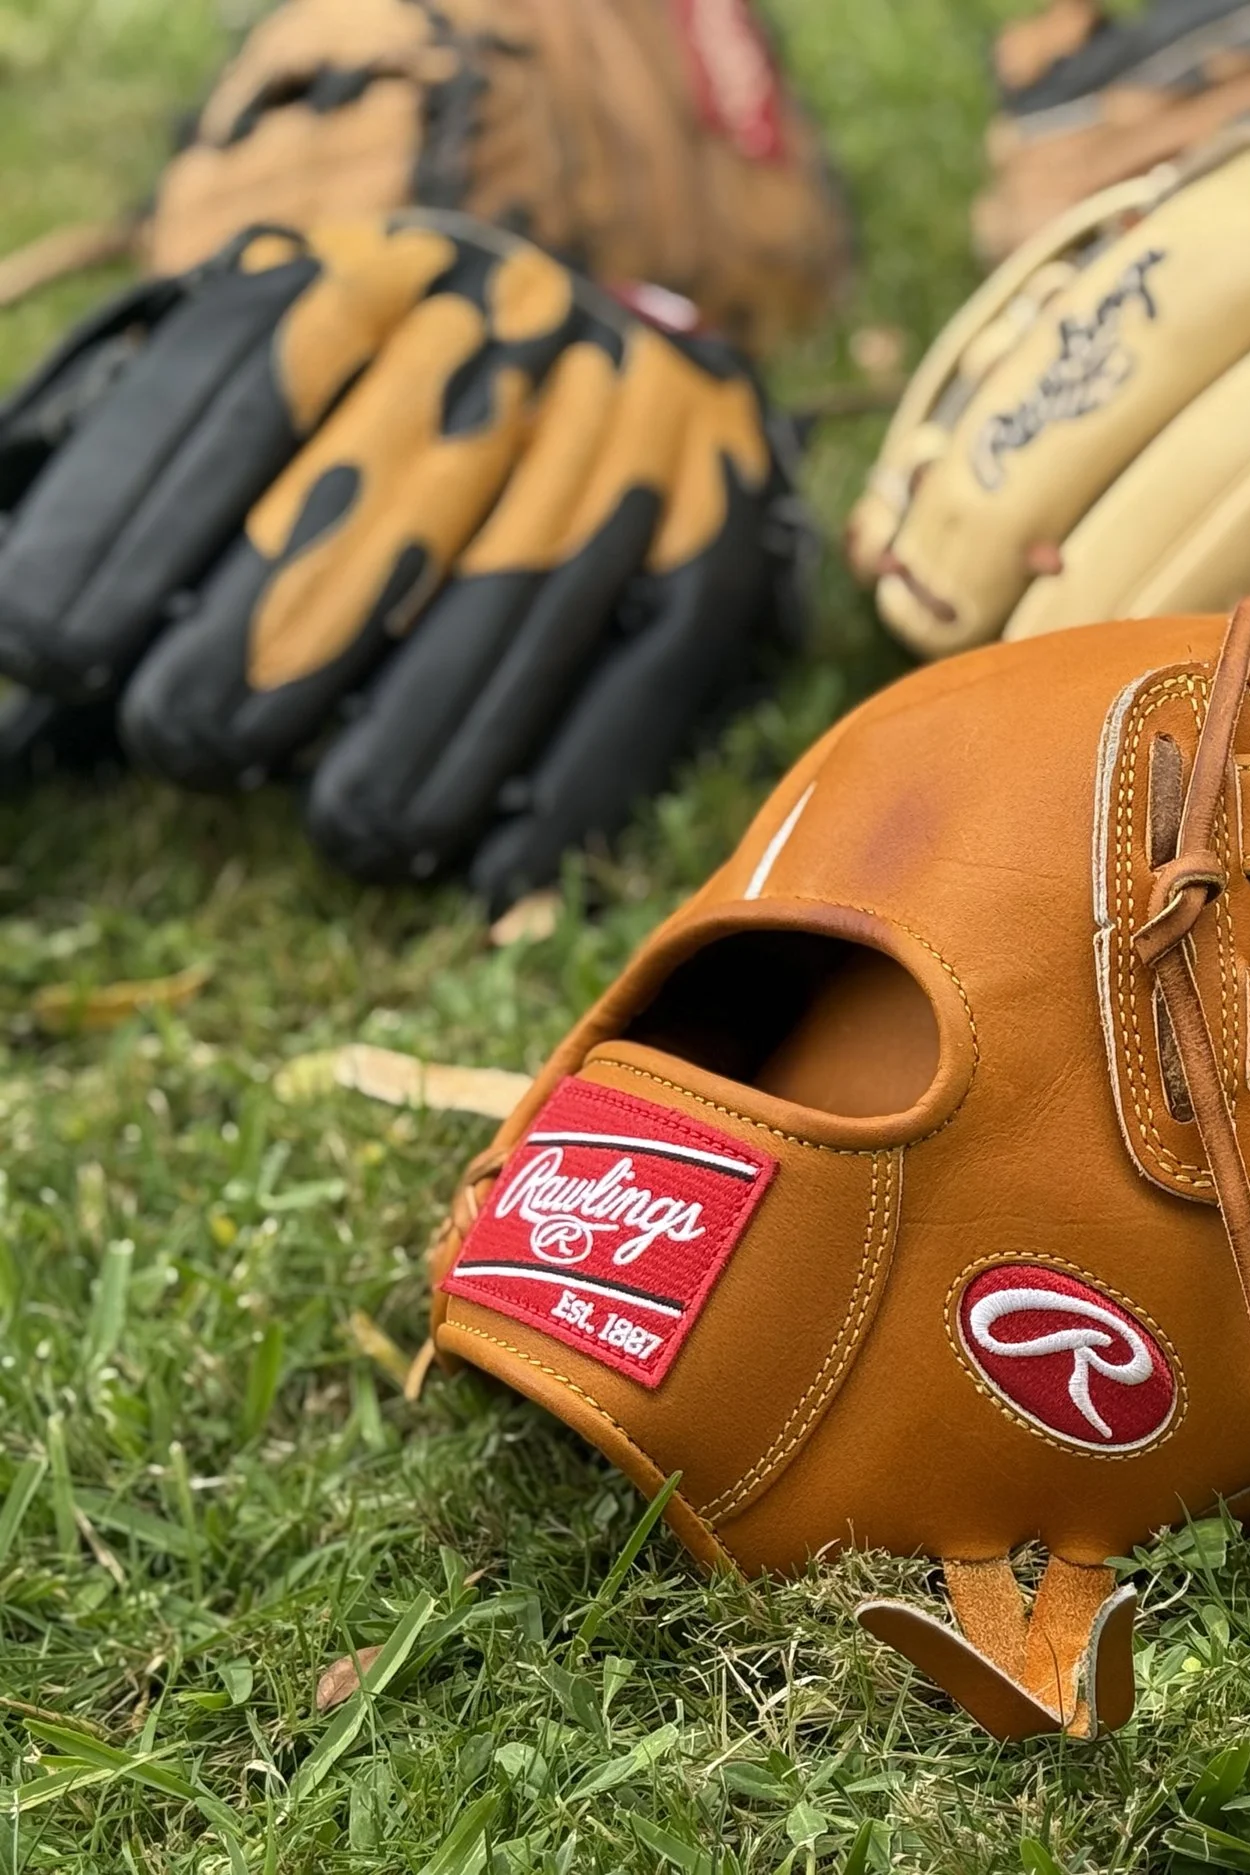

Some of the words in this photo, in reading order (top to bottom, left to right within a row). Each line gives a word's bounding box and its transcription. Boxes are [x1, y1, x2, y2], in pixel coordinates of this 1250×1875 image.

[494, 1146, 707, 1266] Rawlings
[597, 1312, 665, 1360] 1887
[969, 1287, 1154, 1439] R
